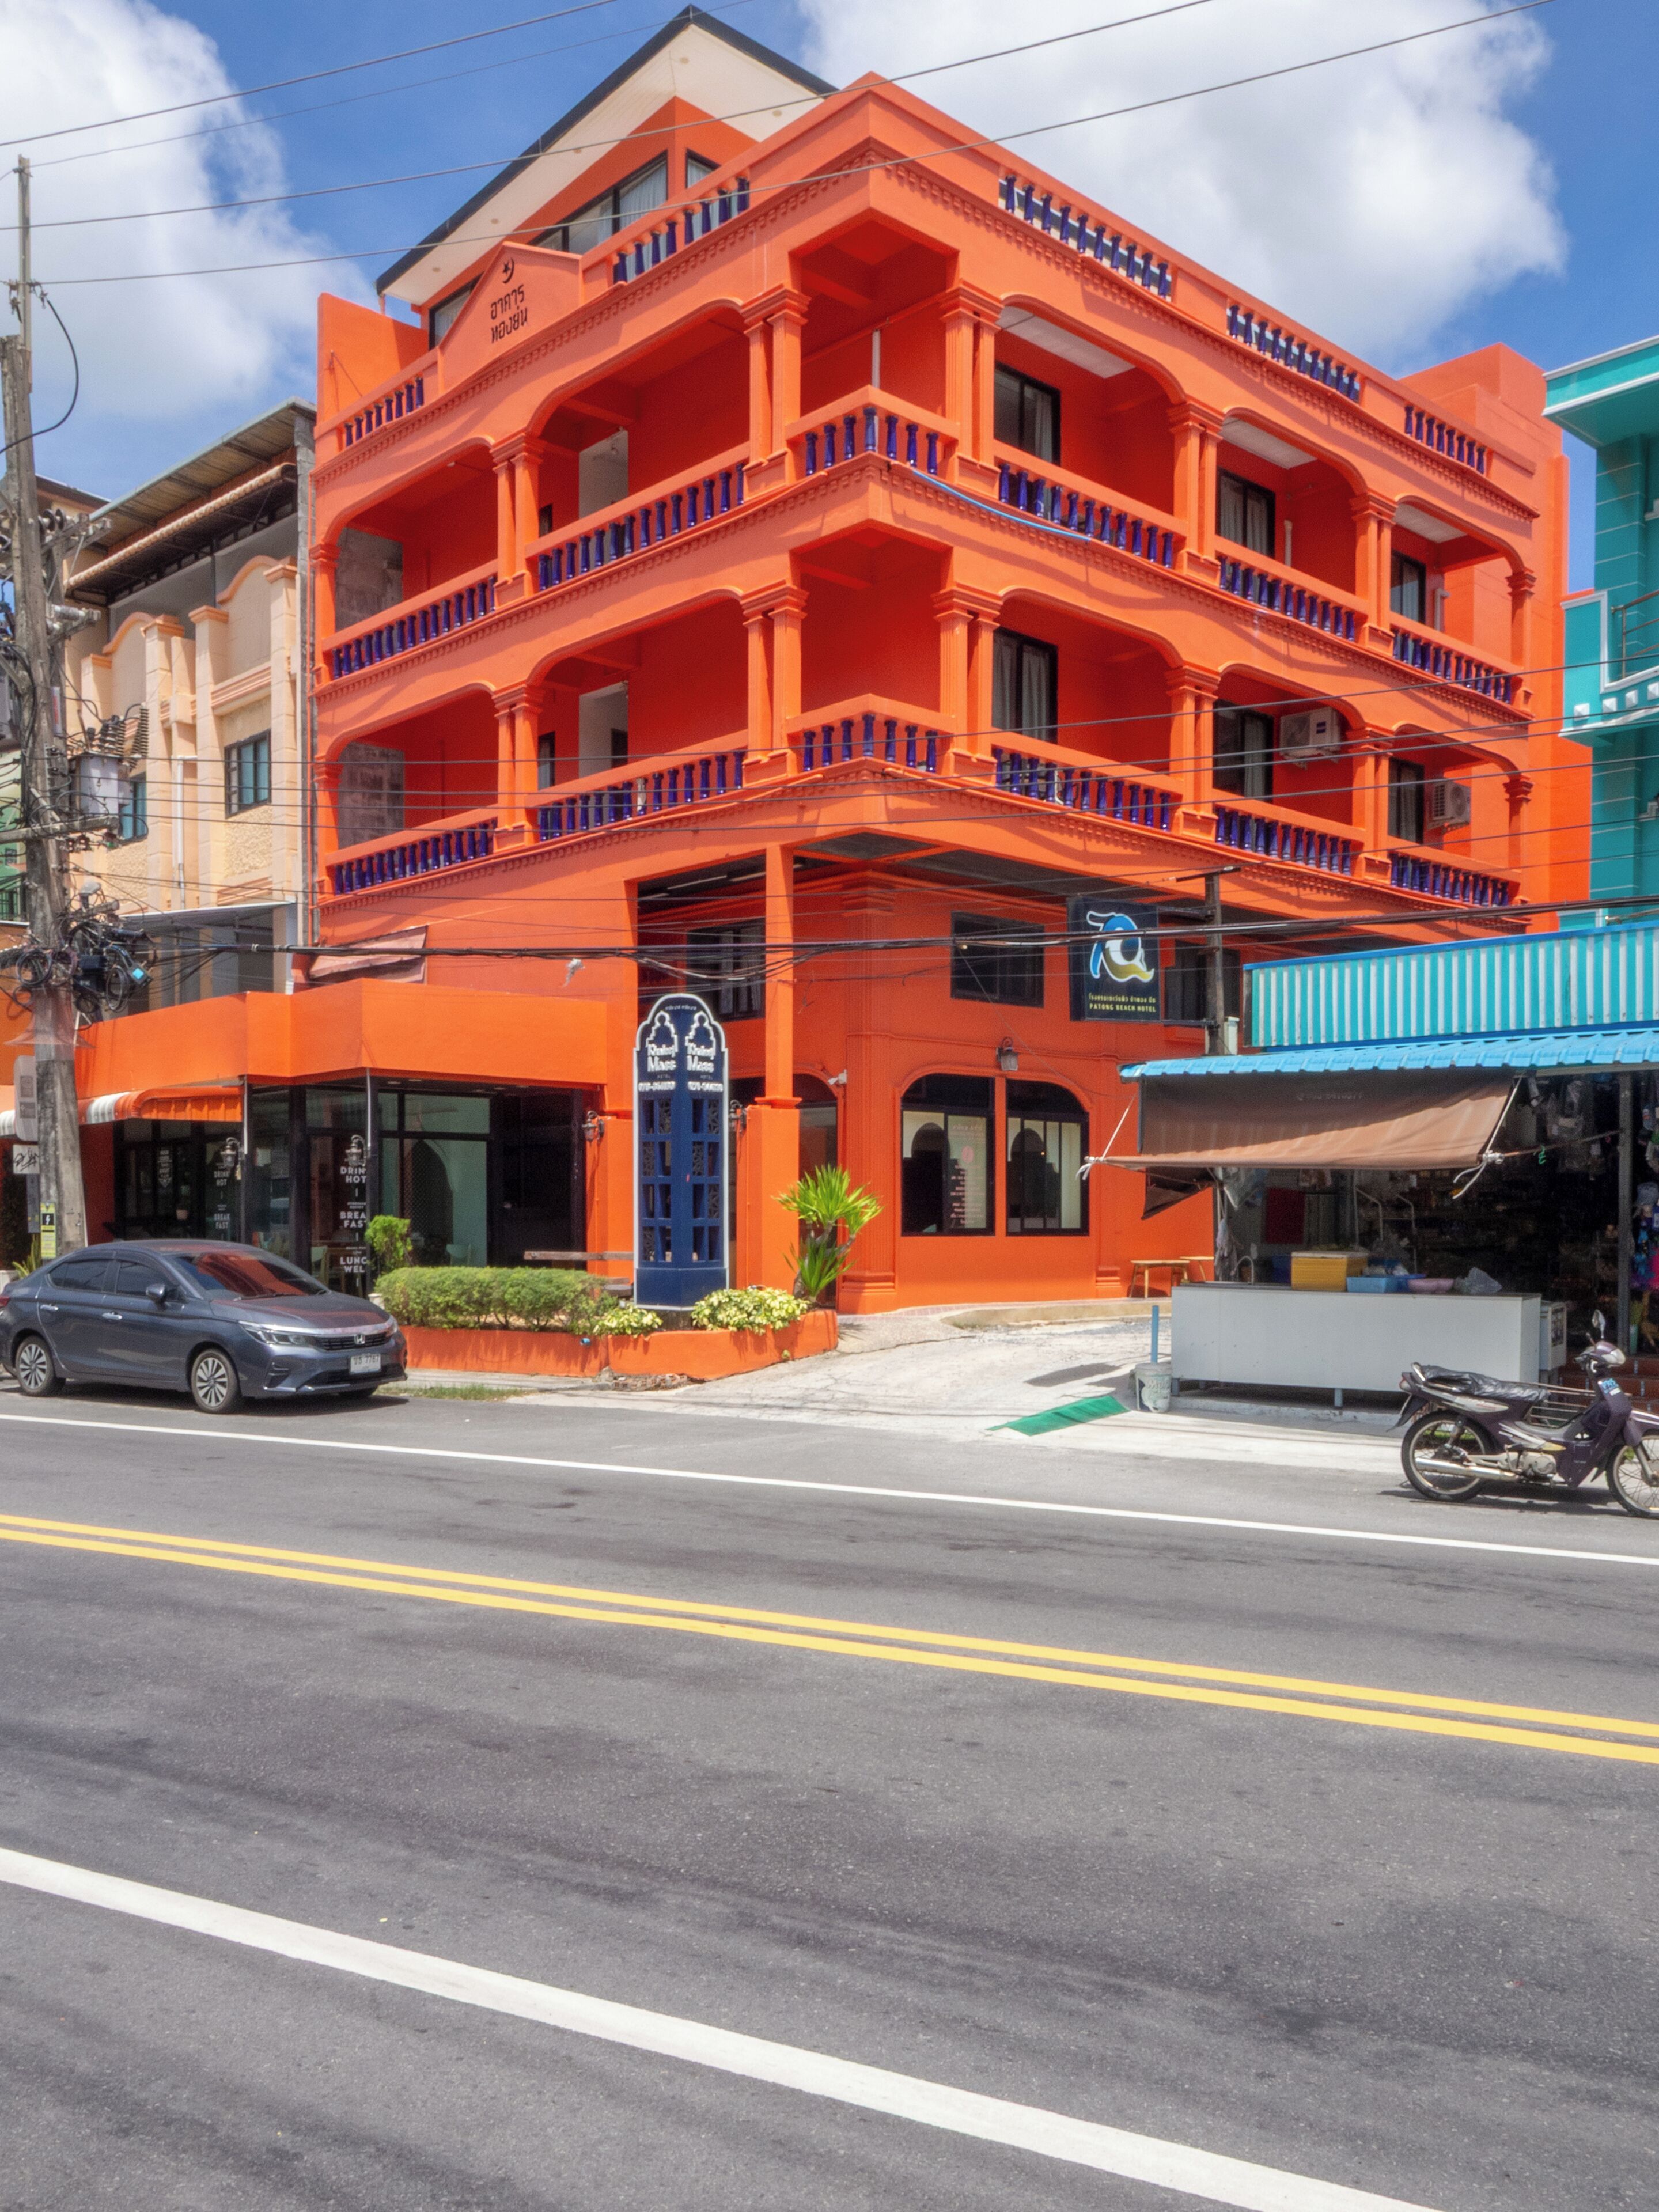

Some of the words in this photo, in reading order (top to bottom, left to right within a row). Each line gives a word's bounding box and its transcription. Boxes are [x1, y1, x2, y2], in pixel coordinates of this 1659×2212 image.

[491, 284, 524, 320] อาคาร
[1089, 1002, 1114, 1010] PATONG
[1116, 1003, 1135, 1012] BEACH
[647, 1055, 676, 1072] Mass
[687, 1055, 715, 1073] Mass
[340, 1166, 366, 1175] DRIN
[346, 1176, 367, 1184] HOT
[340, 1211, 366, 1220] BREA
[340, 1256, 367, 1265] LUNC
[344, 1264, 365, 1273] WEL
